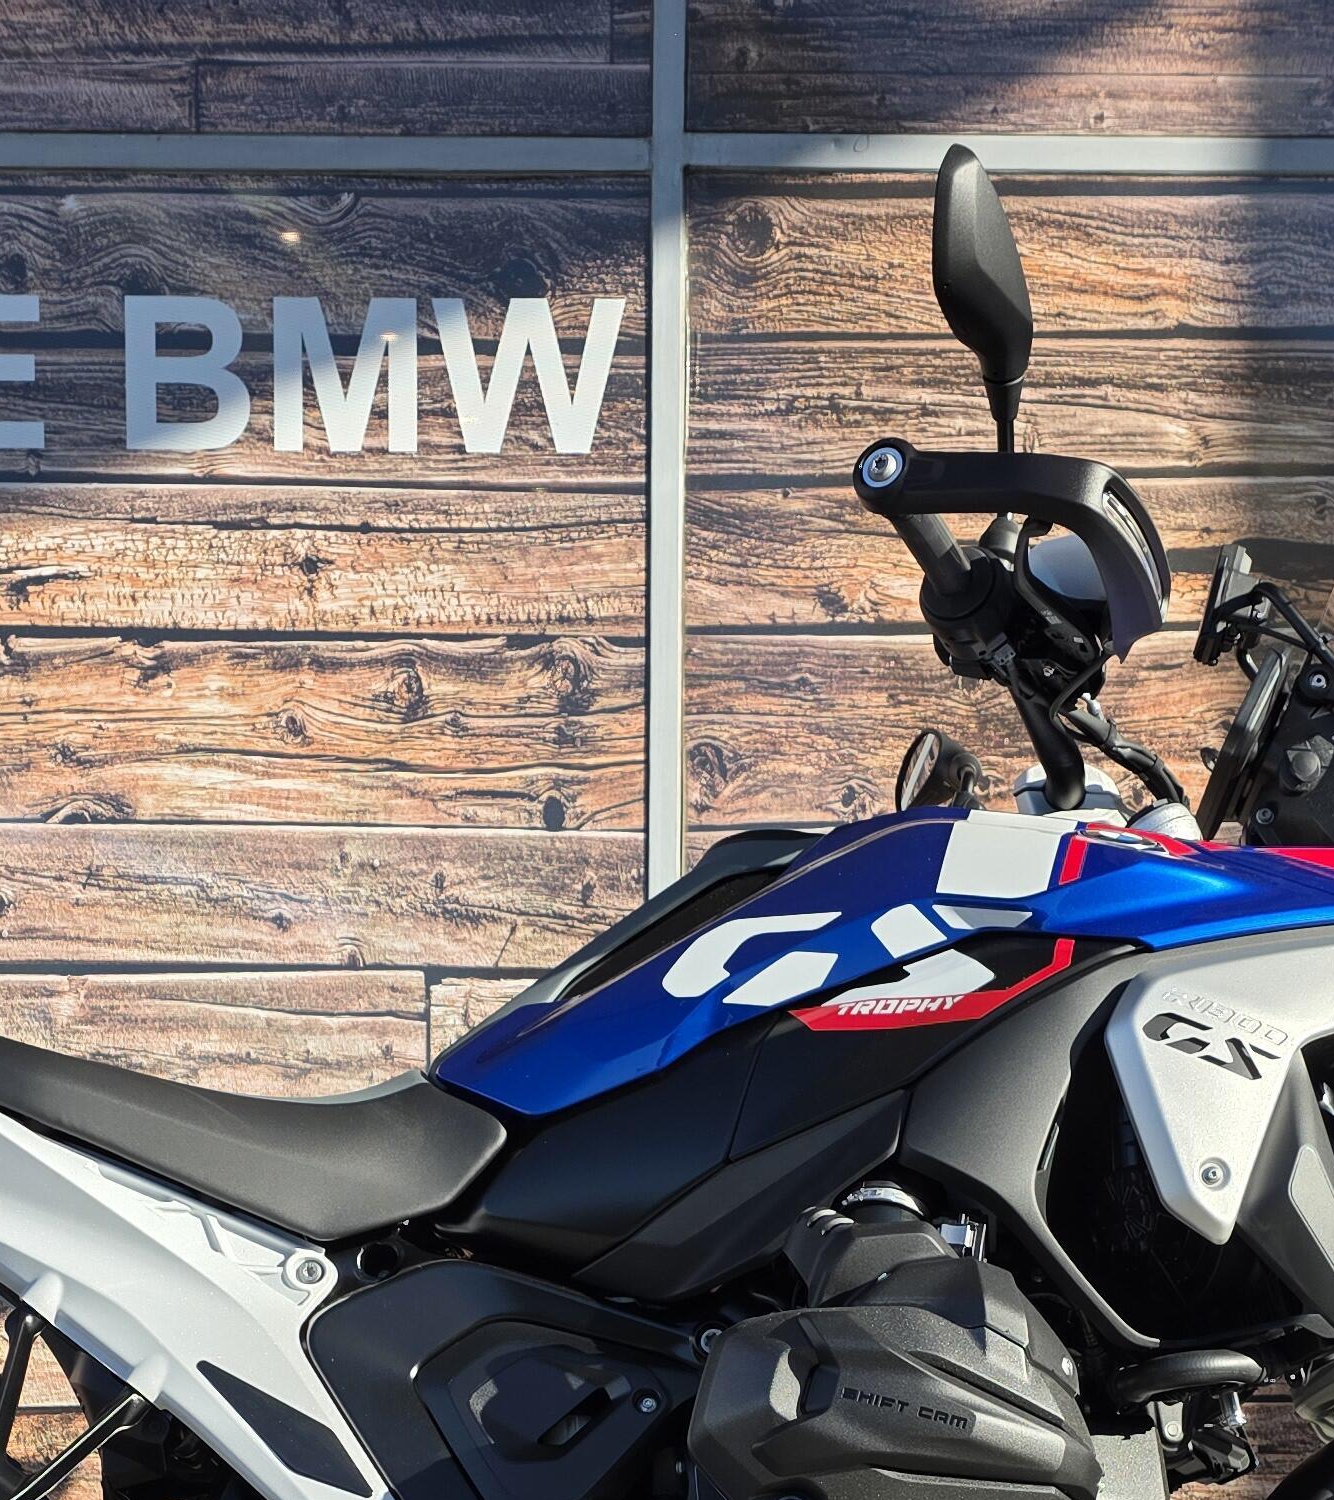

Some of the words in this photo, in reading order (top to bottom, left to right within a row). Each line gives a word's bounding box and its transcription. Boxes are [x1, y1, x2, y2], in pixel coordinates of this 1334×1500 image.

[124, 292, 627, 457] BMW
[837, 994, 965, 1018] TROPHY
[840, 1386, 910, 1413] SHIFT
[917, 1405, 968, 1430] CAM
